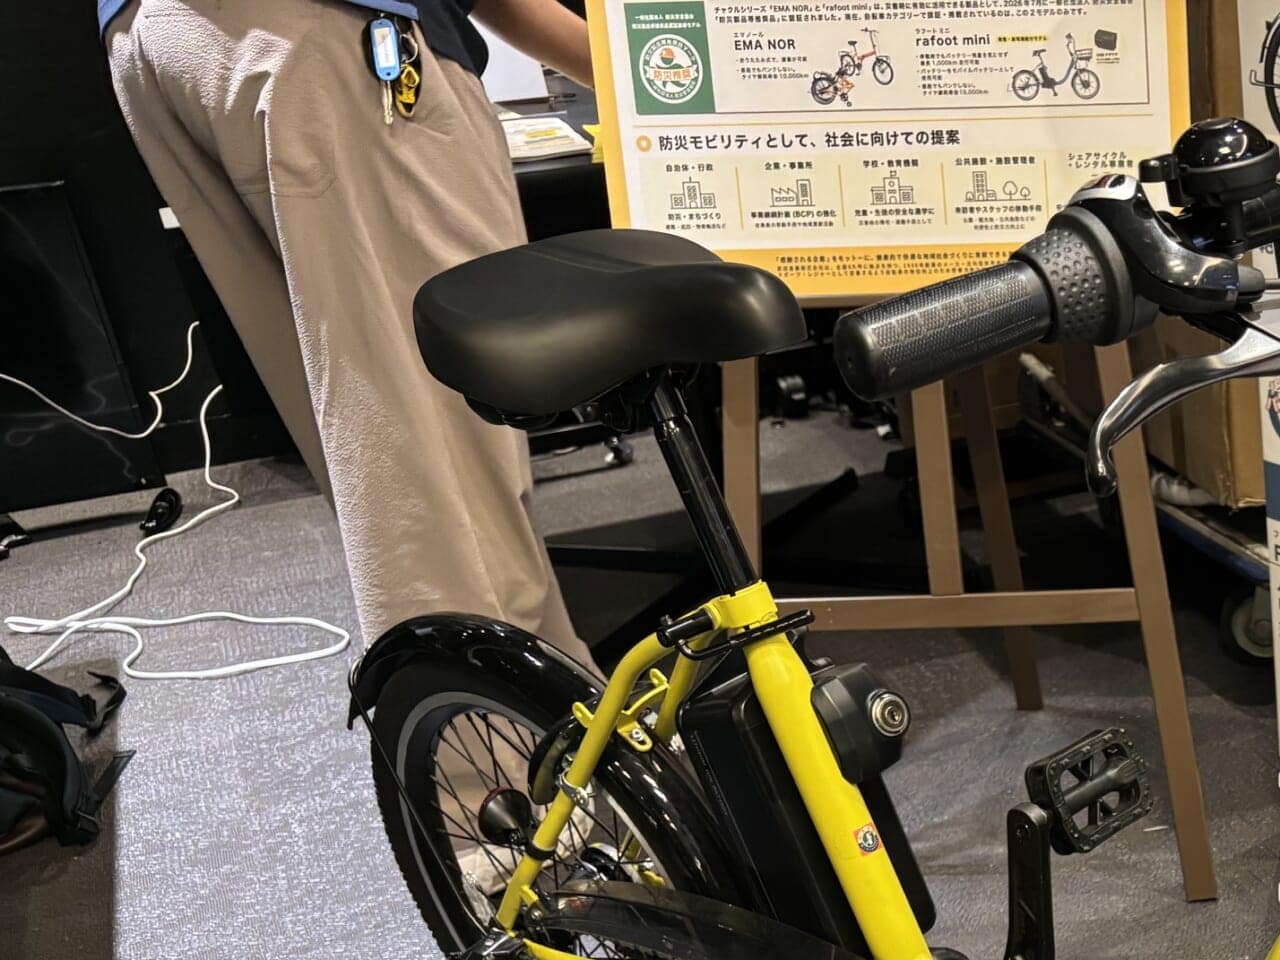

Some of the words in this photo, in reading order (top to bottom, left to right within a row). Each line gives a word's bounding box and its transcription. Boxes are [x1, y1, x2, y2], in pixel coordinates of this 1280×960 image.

[733, 39, 763, 51] EMA
[767, 38, 796, 50] NOR
[915, 35, 958, 47] rafoot
[962, 34, 991, 46] mini
[658, 128, 961, 152] 防災モビリティとして、社会に向けての提案
